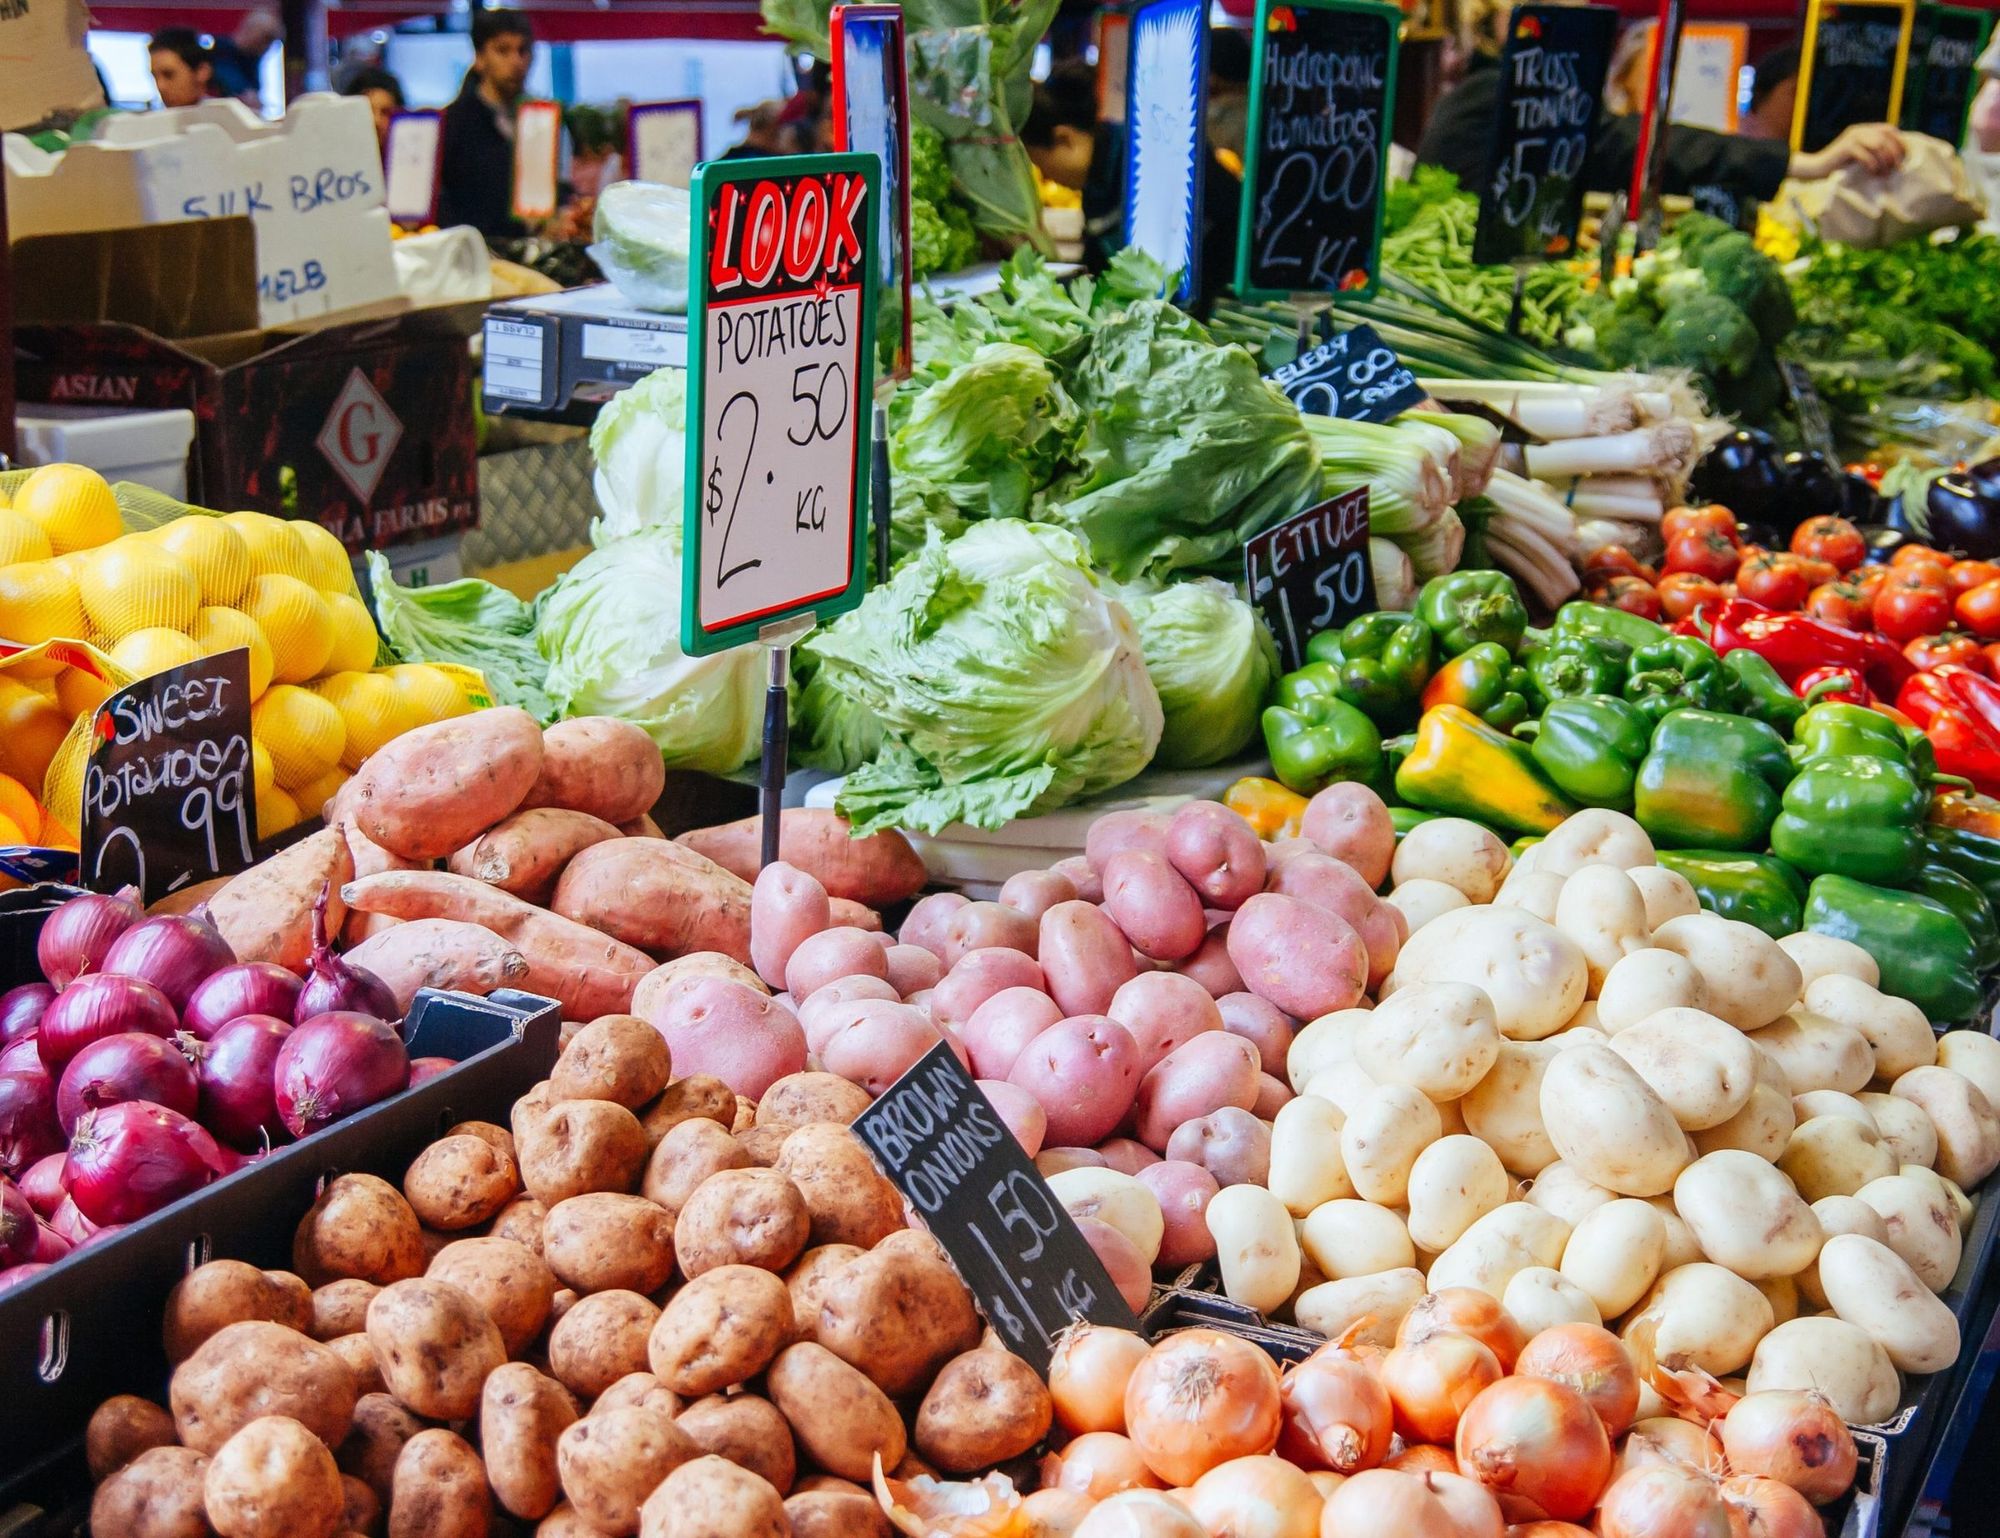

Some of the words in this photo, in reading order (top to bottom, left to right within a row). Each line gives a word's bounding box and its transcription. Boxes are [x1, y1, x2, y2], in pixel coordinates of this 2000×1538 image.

[1263, 43, 1384, 112] Hydroponic
[182, 182, 273, 218] SILK
[290, 167, 371, 213] BROS
[709, 172, 868, 293] LOOK
[717, 293, 848, 374] POTATOES
[1261, 332, 1349, 385] ELERY
[51, 375, 139, 400] ASIAN
[338, 401, 383, 466] G
[373, 498, 449, 538] FARMS
[796, 485, 826, 534] KG
[1251, 493, 1369, 601] LETTUCE
[1261, 552, 1365, 672] 1.50
[113, 676, 231, 746] SWEET
[863, 1056, 968, 1172] BROWN
[905, 1102, 1003, 1214] ONIONS
